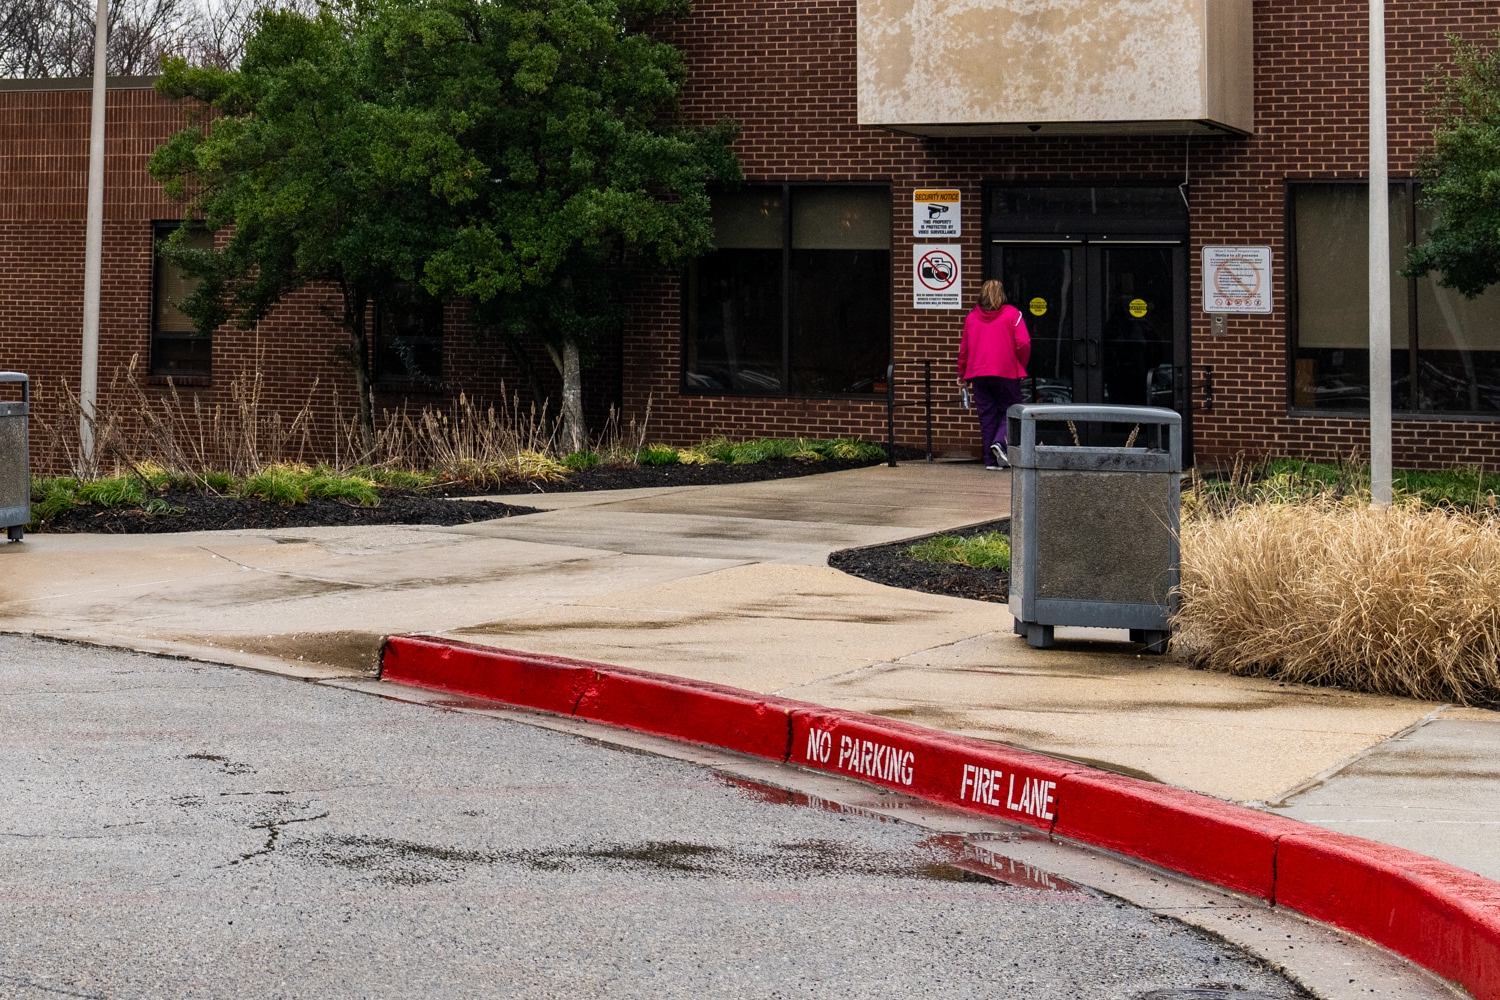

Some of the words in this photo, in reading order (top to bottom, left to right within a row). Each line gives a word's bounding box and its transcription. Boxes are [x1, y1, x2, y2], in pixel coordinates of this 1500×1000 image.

[915, 193, 940, 201] SECURITY
[940, 193, 959, 201] NOTICE
[806, 727, 831, 763] NO
[838, 735, 915, 786] PARKING
[960, 763, 1002, 807] FIRE
[1006, 773, 1057, 820] LANE
